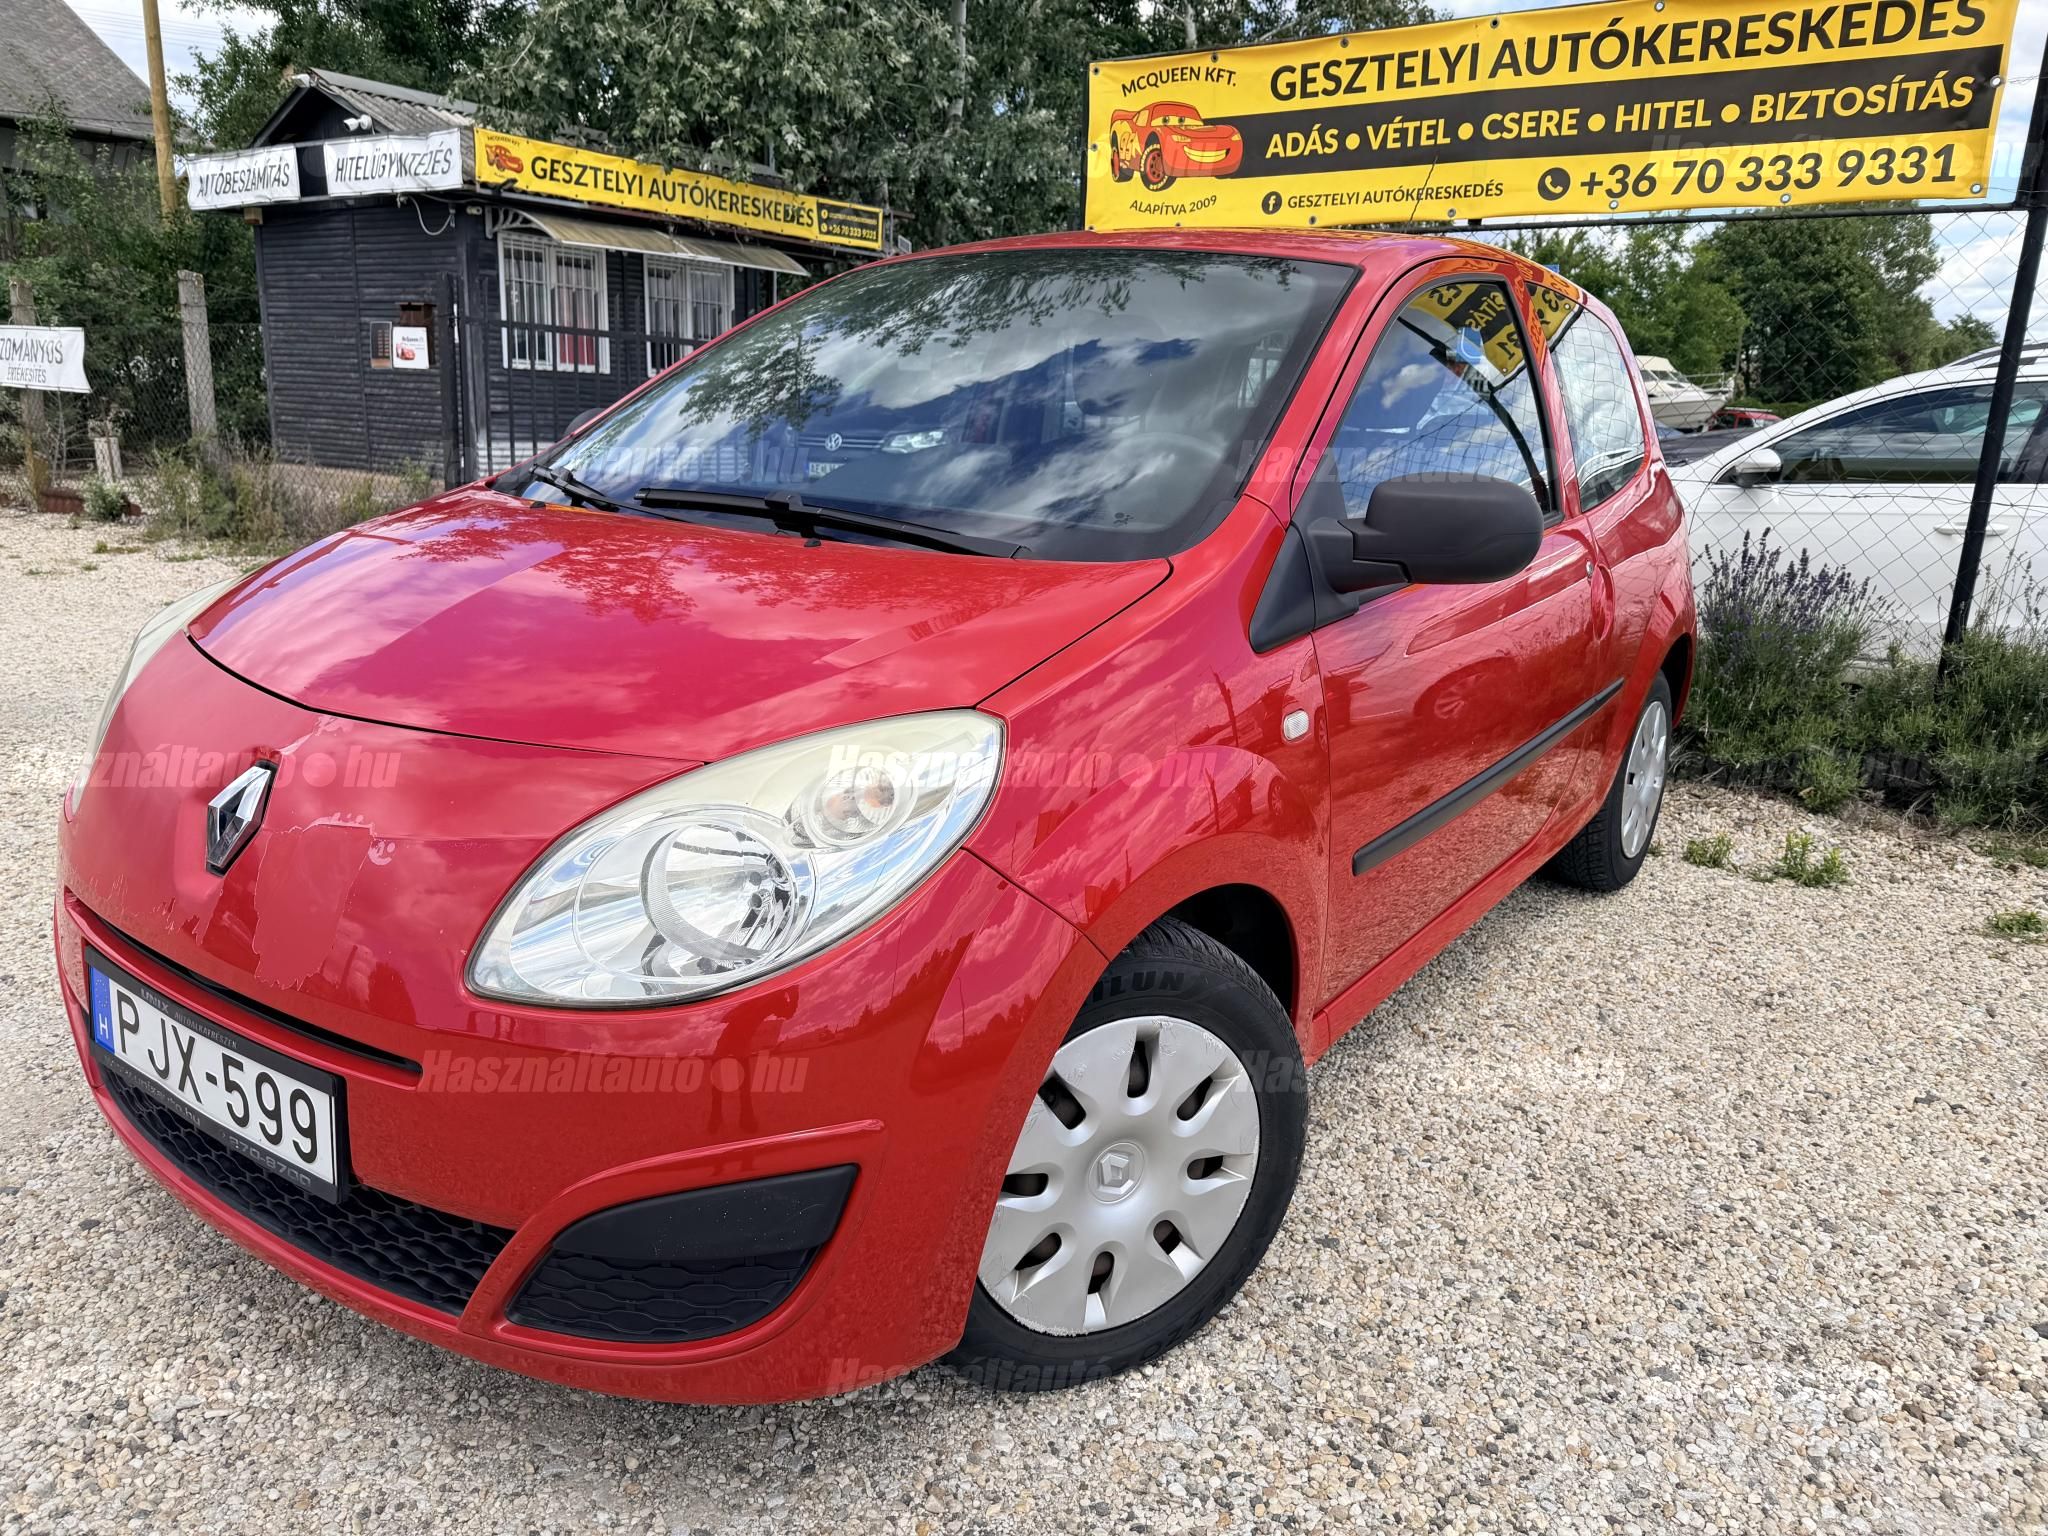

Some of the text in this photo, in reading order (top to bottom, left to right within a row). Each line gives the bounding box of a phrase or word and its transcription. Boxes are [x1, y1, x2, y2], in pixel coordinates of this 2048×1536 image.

[1121, 66, 1237, 97] MCQUEEN KFT.
[1270, 42, 1480, 102] GESZTELYI
[1265, 123, 1339, 159] ADÁS
[1367, 115, 1451, 151] VÉTEL
[1482, 108, 1581, 140] CSERE
[1615, 98, 1712, 134] HITEL
[1750, 70, 1975, 124] BIZTOSÍTÁS
[531, 156, 814, 228] GESZTELYI AUTÓKERESKEDÉS
[1287, 180, 1504, 209] GESZTELYI AUTÓKERESKEDÉS
[1580, 143, 1957, 199] +36 70 333 9331
[1129, 195, 1217, 216] ALAPÍTVA 2009
[99, 1014, 108, 1039] H
[117, 989, 317, 1164] PJX-599
